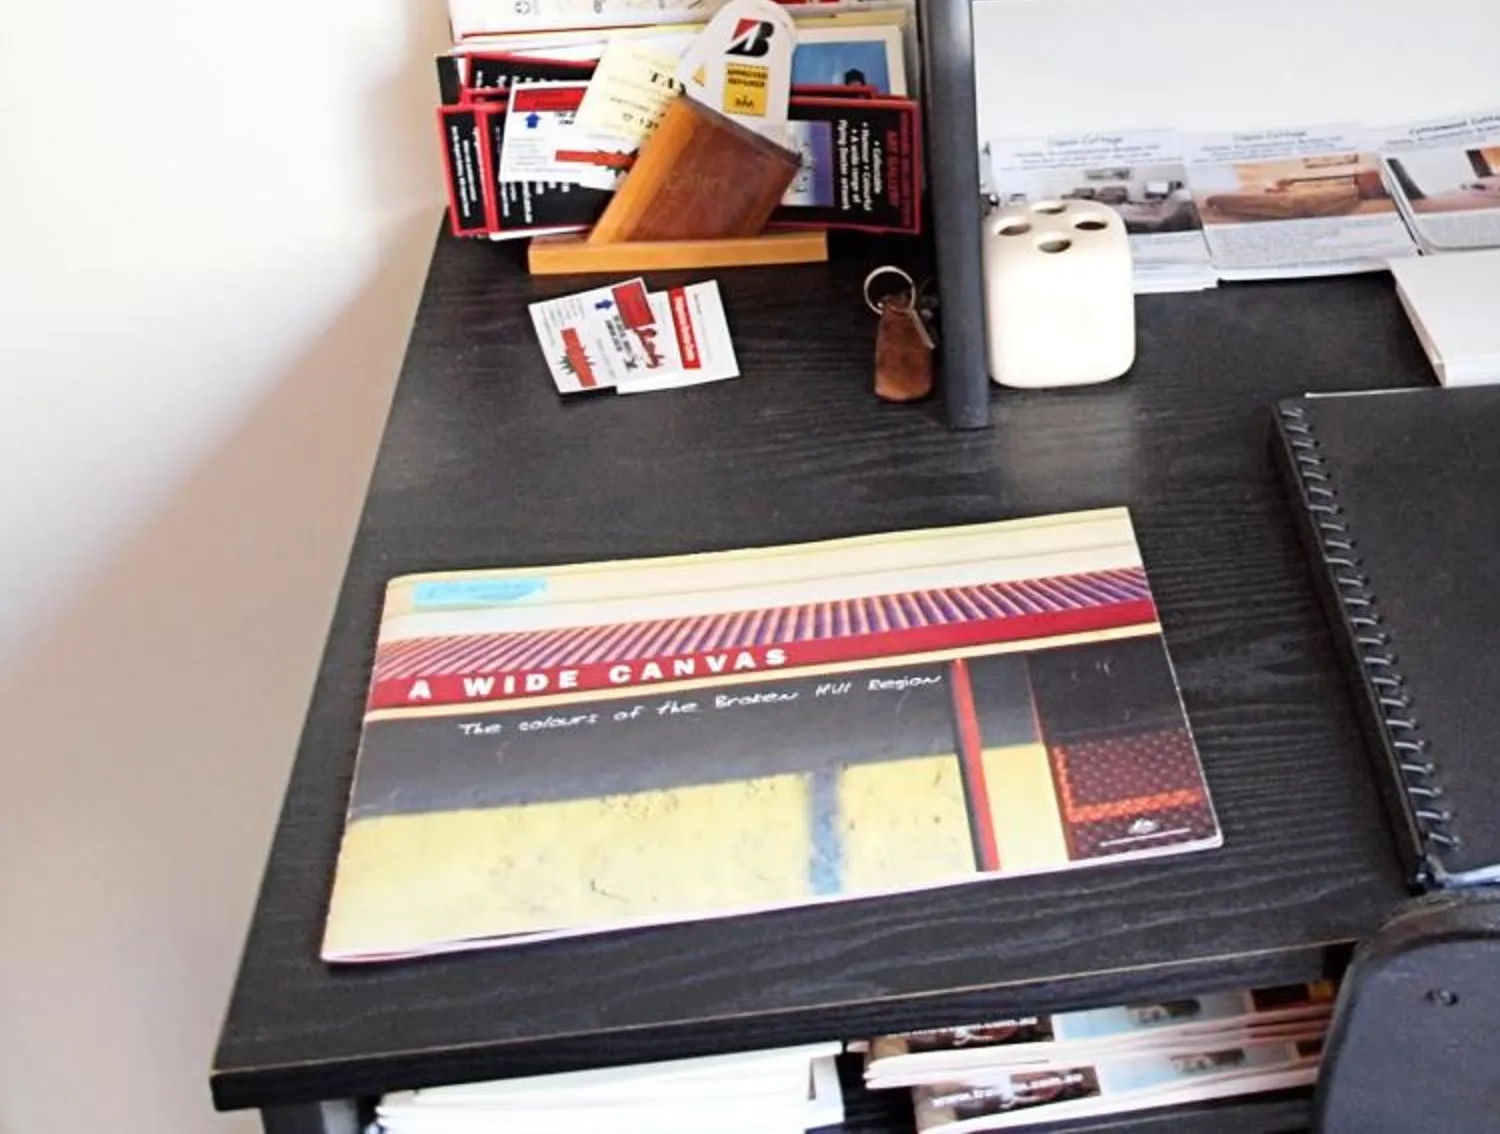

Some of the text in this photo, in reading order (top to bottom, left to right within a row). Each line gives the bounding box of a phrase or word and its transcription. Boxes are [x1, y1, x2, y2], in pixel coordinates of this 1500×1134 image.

[408, 647, 789, 700] A WIDE CANVAS
[459, 674, 943, 737] The colours of the Broken Hill Region
